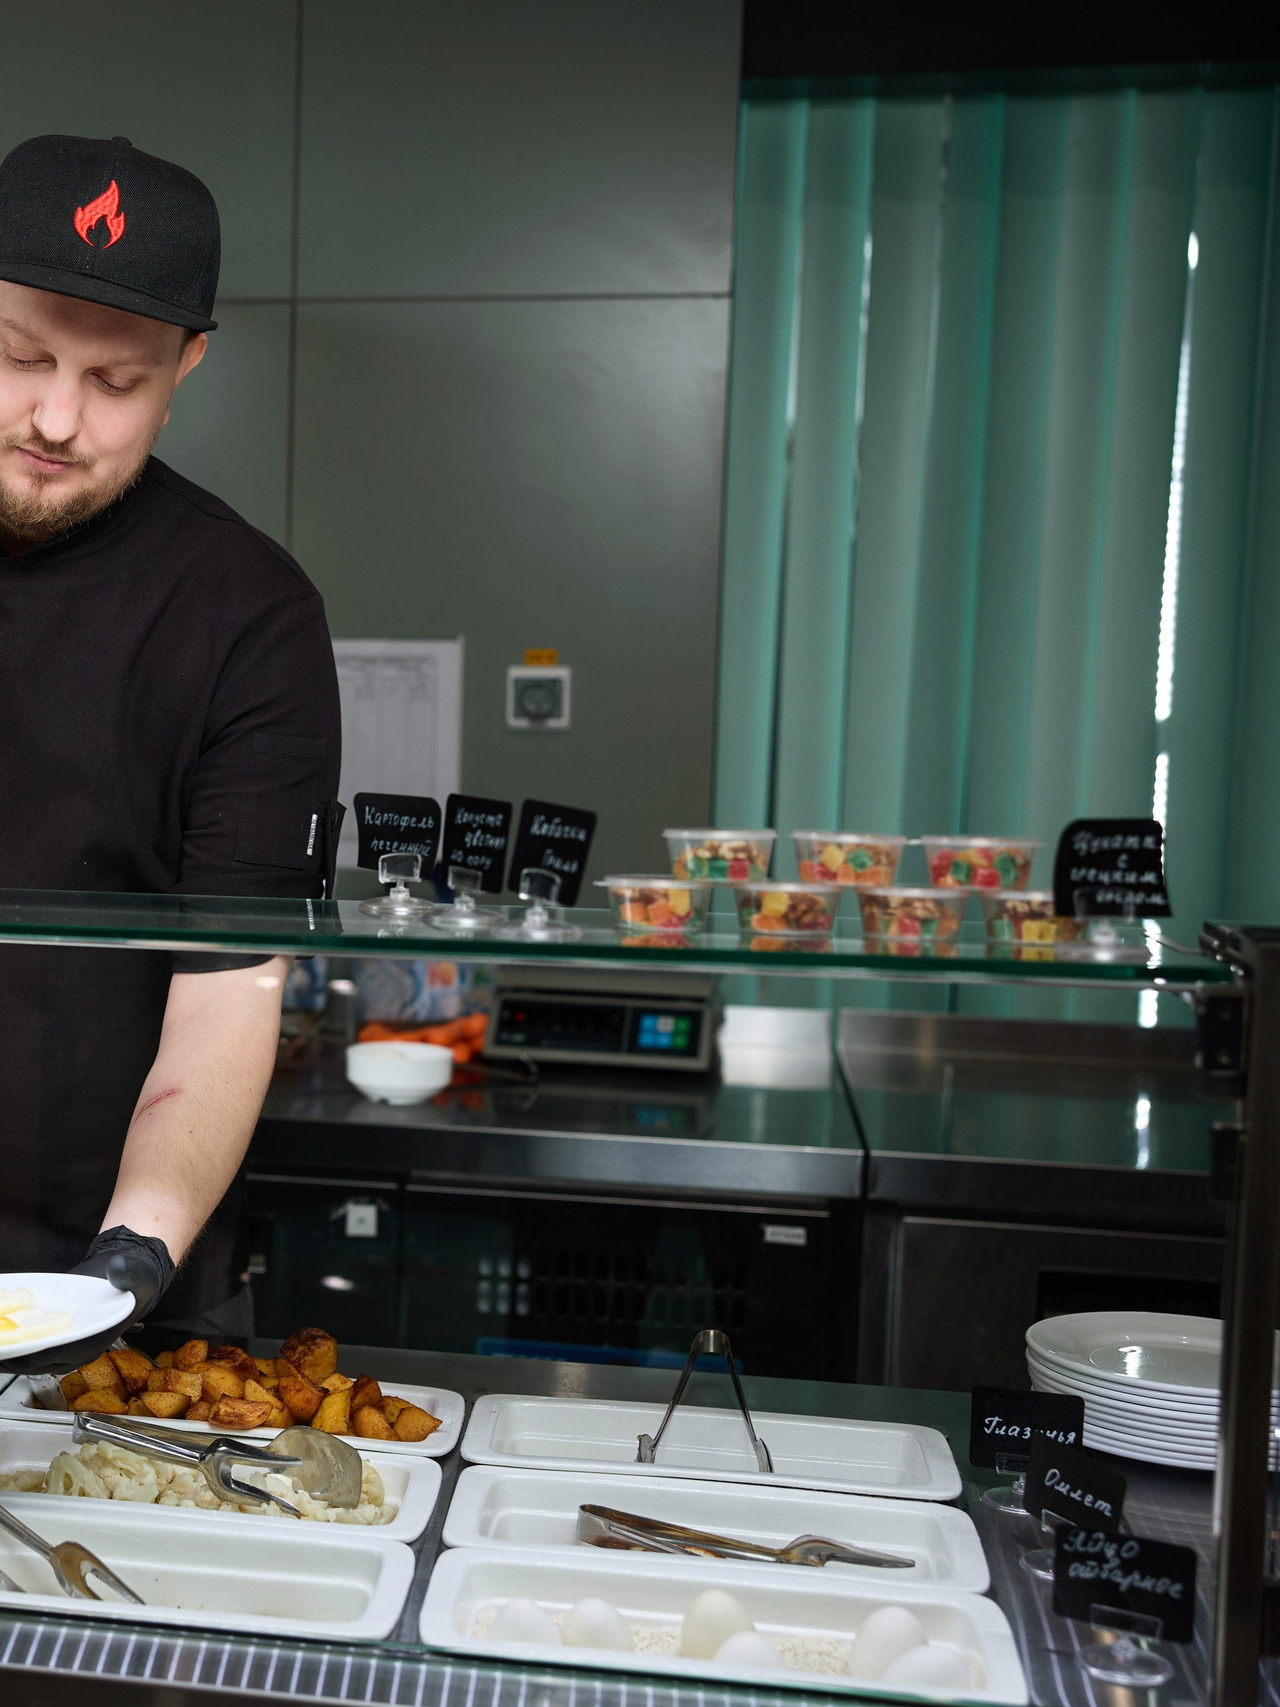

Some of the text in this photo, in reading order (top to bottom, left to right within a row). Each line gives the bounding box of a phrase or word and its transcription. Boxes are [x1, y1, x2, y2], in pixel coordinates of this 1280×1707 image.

[364, 805, 435, 832] Картофель
[454, 806, 504, 829] Капуста
[530, 813, 588, 842] Кабачки
[370, 838, 433, 857] печенный
[1044, 1467, 1114, 1518] Омлет
[1062, 1528, 1140, 1561] Яйцо
[1067, 1557, 1185, 1600] отварное
